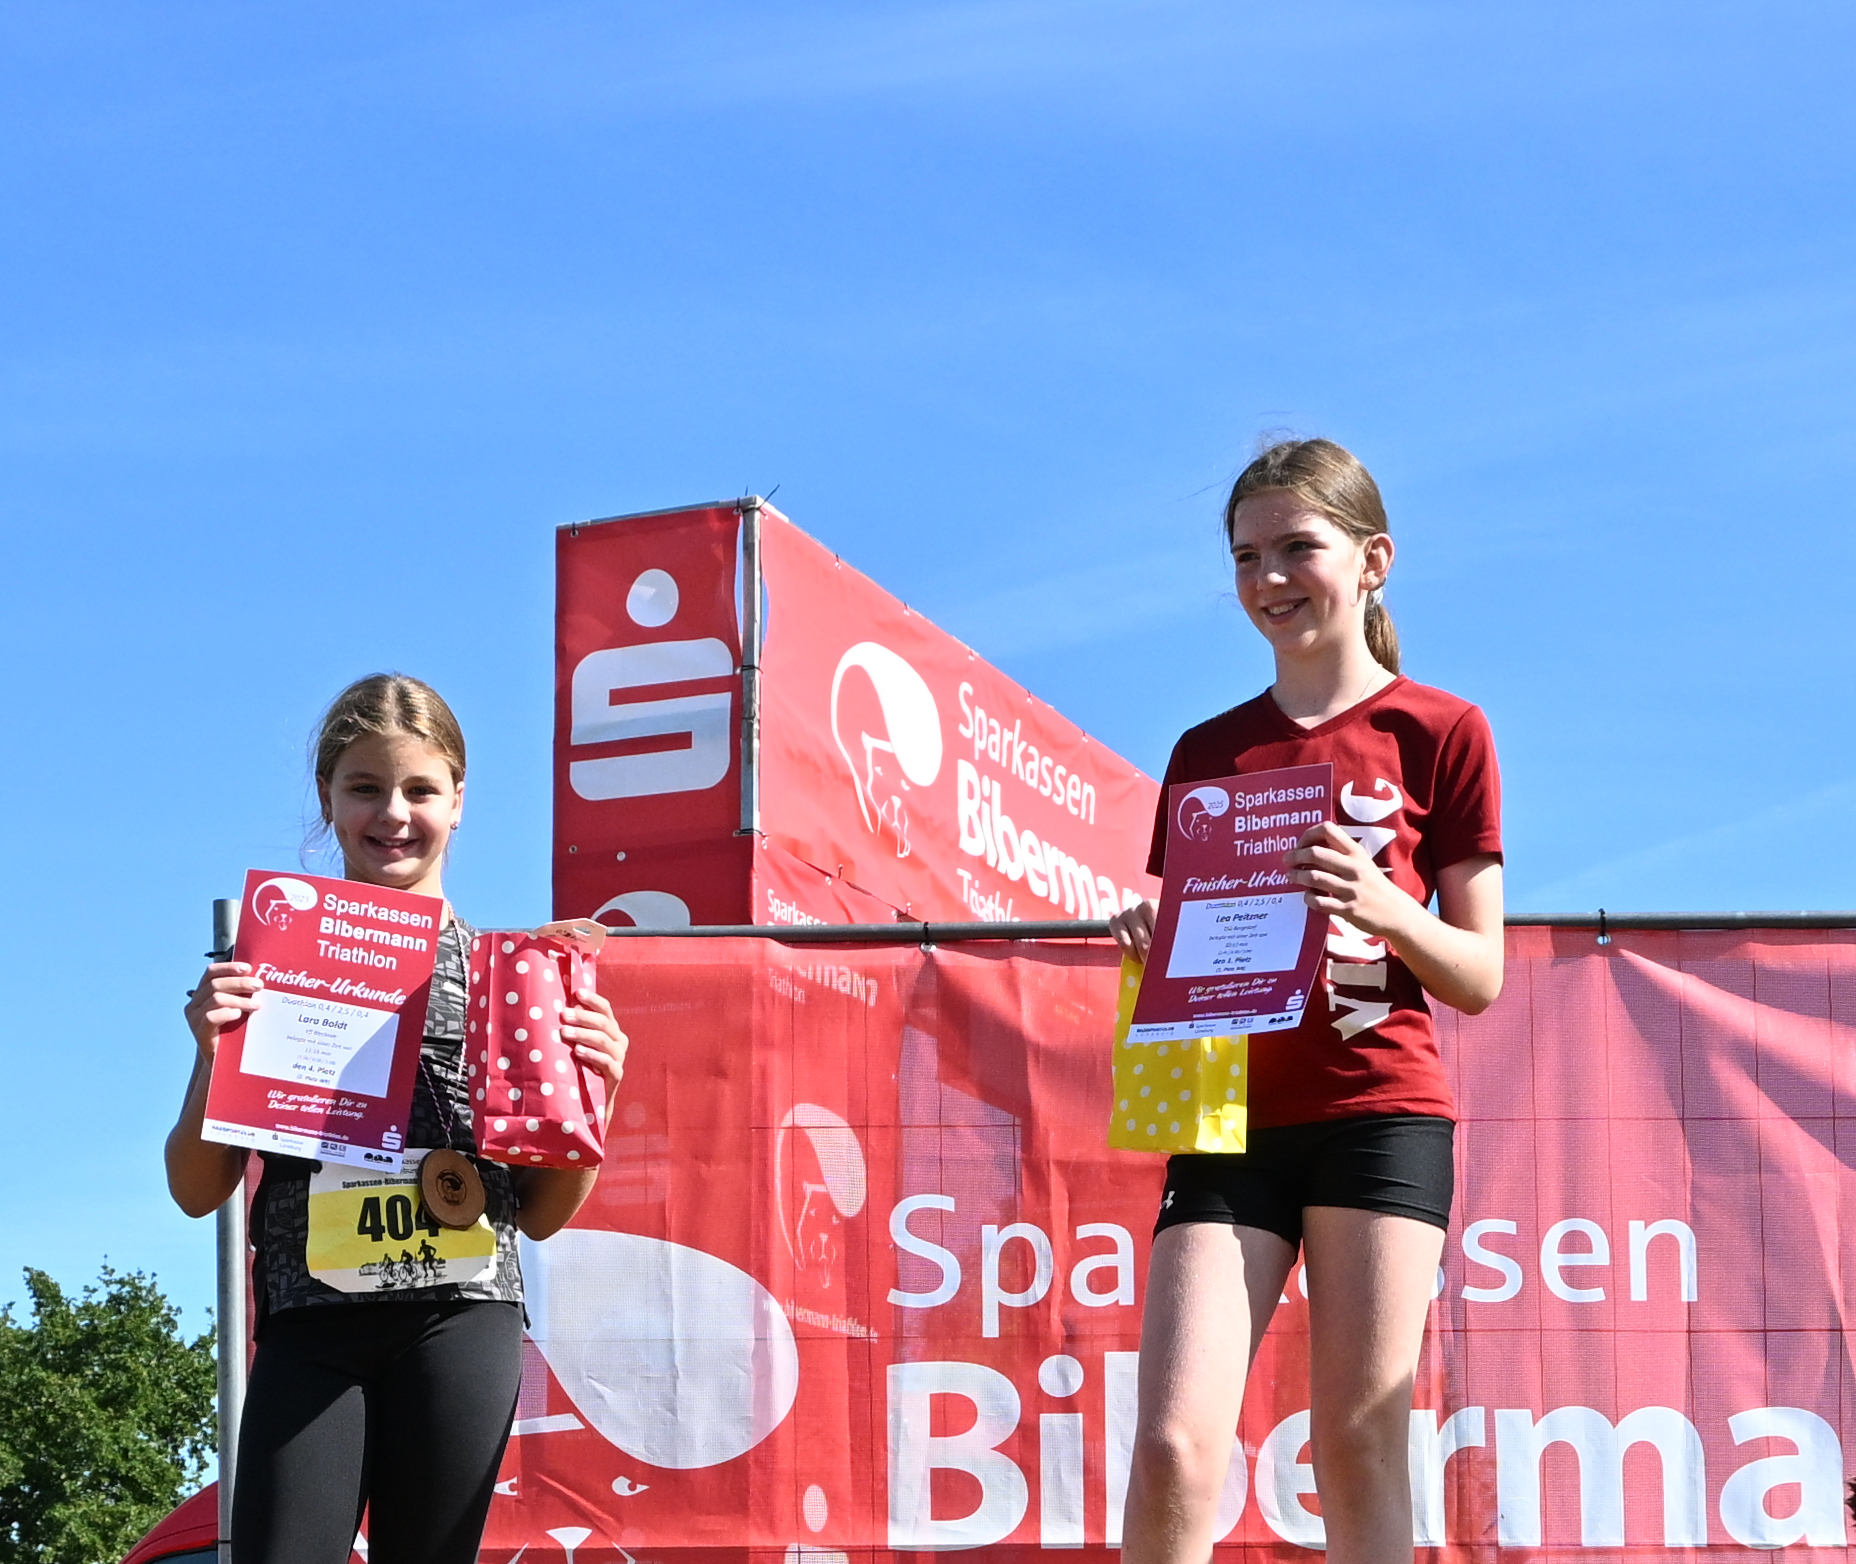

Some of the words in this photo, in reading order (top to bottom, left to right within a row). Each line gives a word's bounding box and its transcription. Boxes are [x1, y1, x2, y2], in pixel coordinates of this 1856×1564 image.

[958, 681, 1096, 826] Sparkassen
[1232, 779, 1326, 813] Sparkassen
[1232, 805, 1324, 834] Bibermann
[957, 758, 1144, 921] Biberma
[1231, 832, 1299, 858] Triathlon
[322, 893, 434, 929] Sparkassen
[319, 916, 429, 951] Bibermann
[314, 939, 398, 970] Triathlon
[254, 962, 408, 1006] Finisher-Urkunde
[298, 1014, 319, 1025] Lara
[321, 1018, 347, 1030] Boldt
[317, 1066, 336, 1075] Platz
